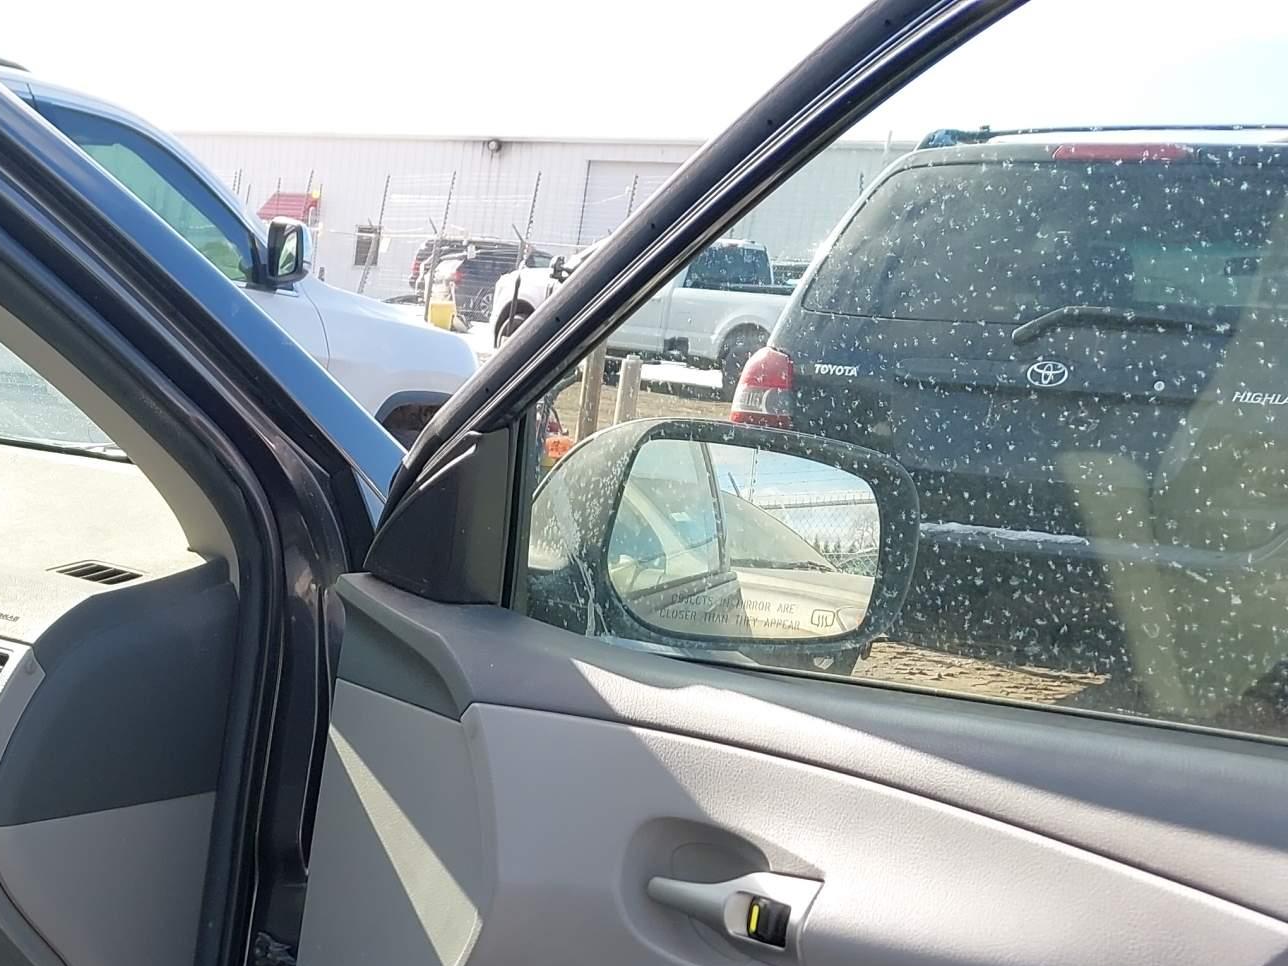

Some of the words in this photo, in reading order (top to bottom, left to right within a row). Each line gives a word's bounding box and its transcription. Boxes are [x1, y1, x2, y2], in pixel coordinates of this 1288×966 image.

[815, 363, 858, 377] TOYOTA
[777, 602, 796, 614] ARE
[660, 608, 697, 621] CLOSER
[704, 611, 729, 624] THAN
[735, 615, 760, 627] THEY
[763, 617, 800, 630] APPEAR
